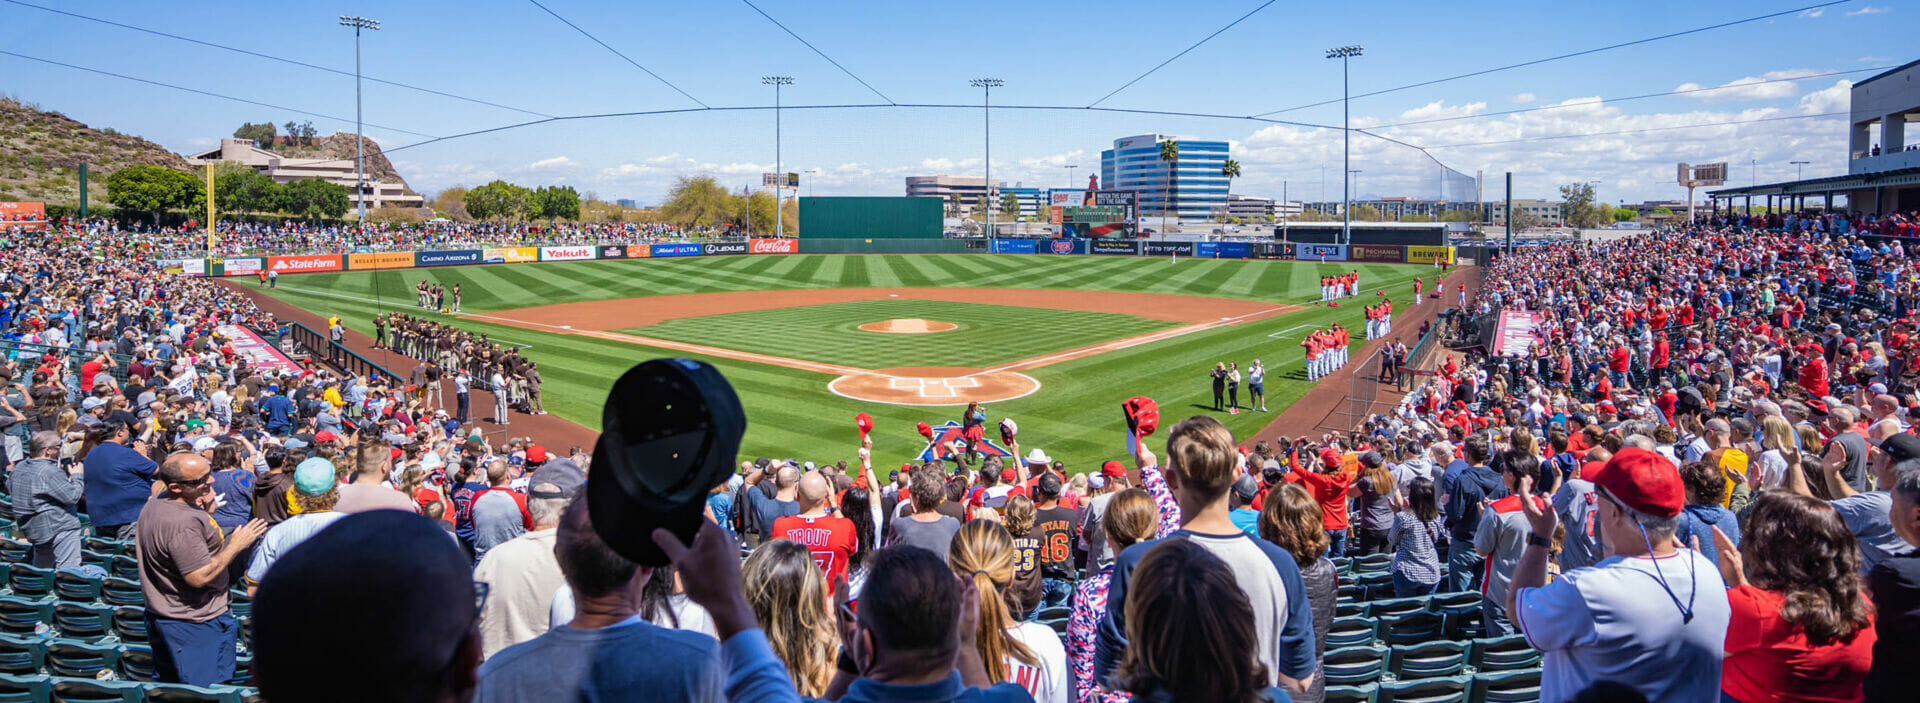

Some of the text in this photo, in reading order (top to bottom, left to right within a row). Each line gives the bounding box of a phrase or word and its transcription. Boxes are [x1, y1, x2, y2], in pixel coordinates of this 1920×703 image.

[547, 249, 590, 258] Yakult
[754, 239, 792, 253] Coca-Cola
[787, 528, 832, 547] TROUT
[1041, 533, 1070, 562] 16
[1013, 549, 1035, 571] 23
